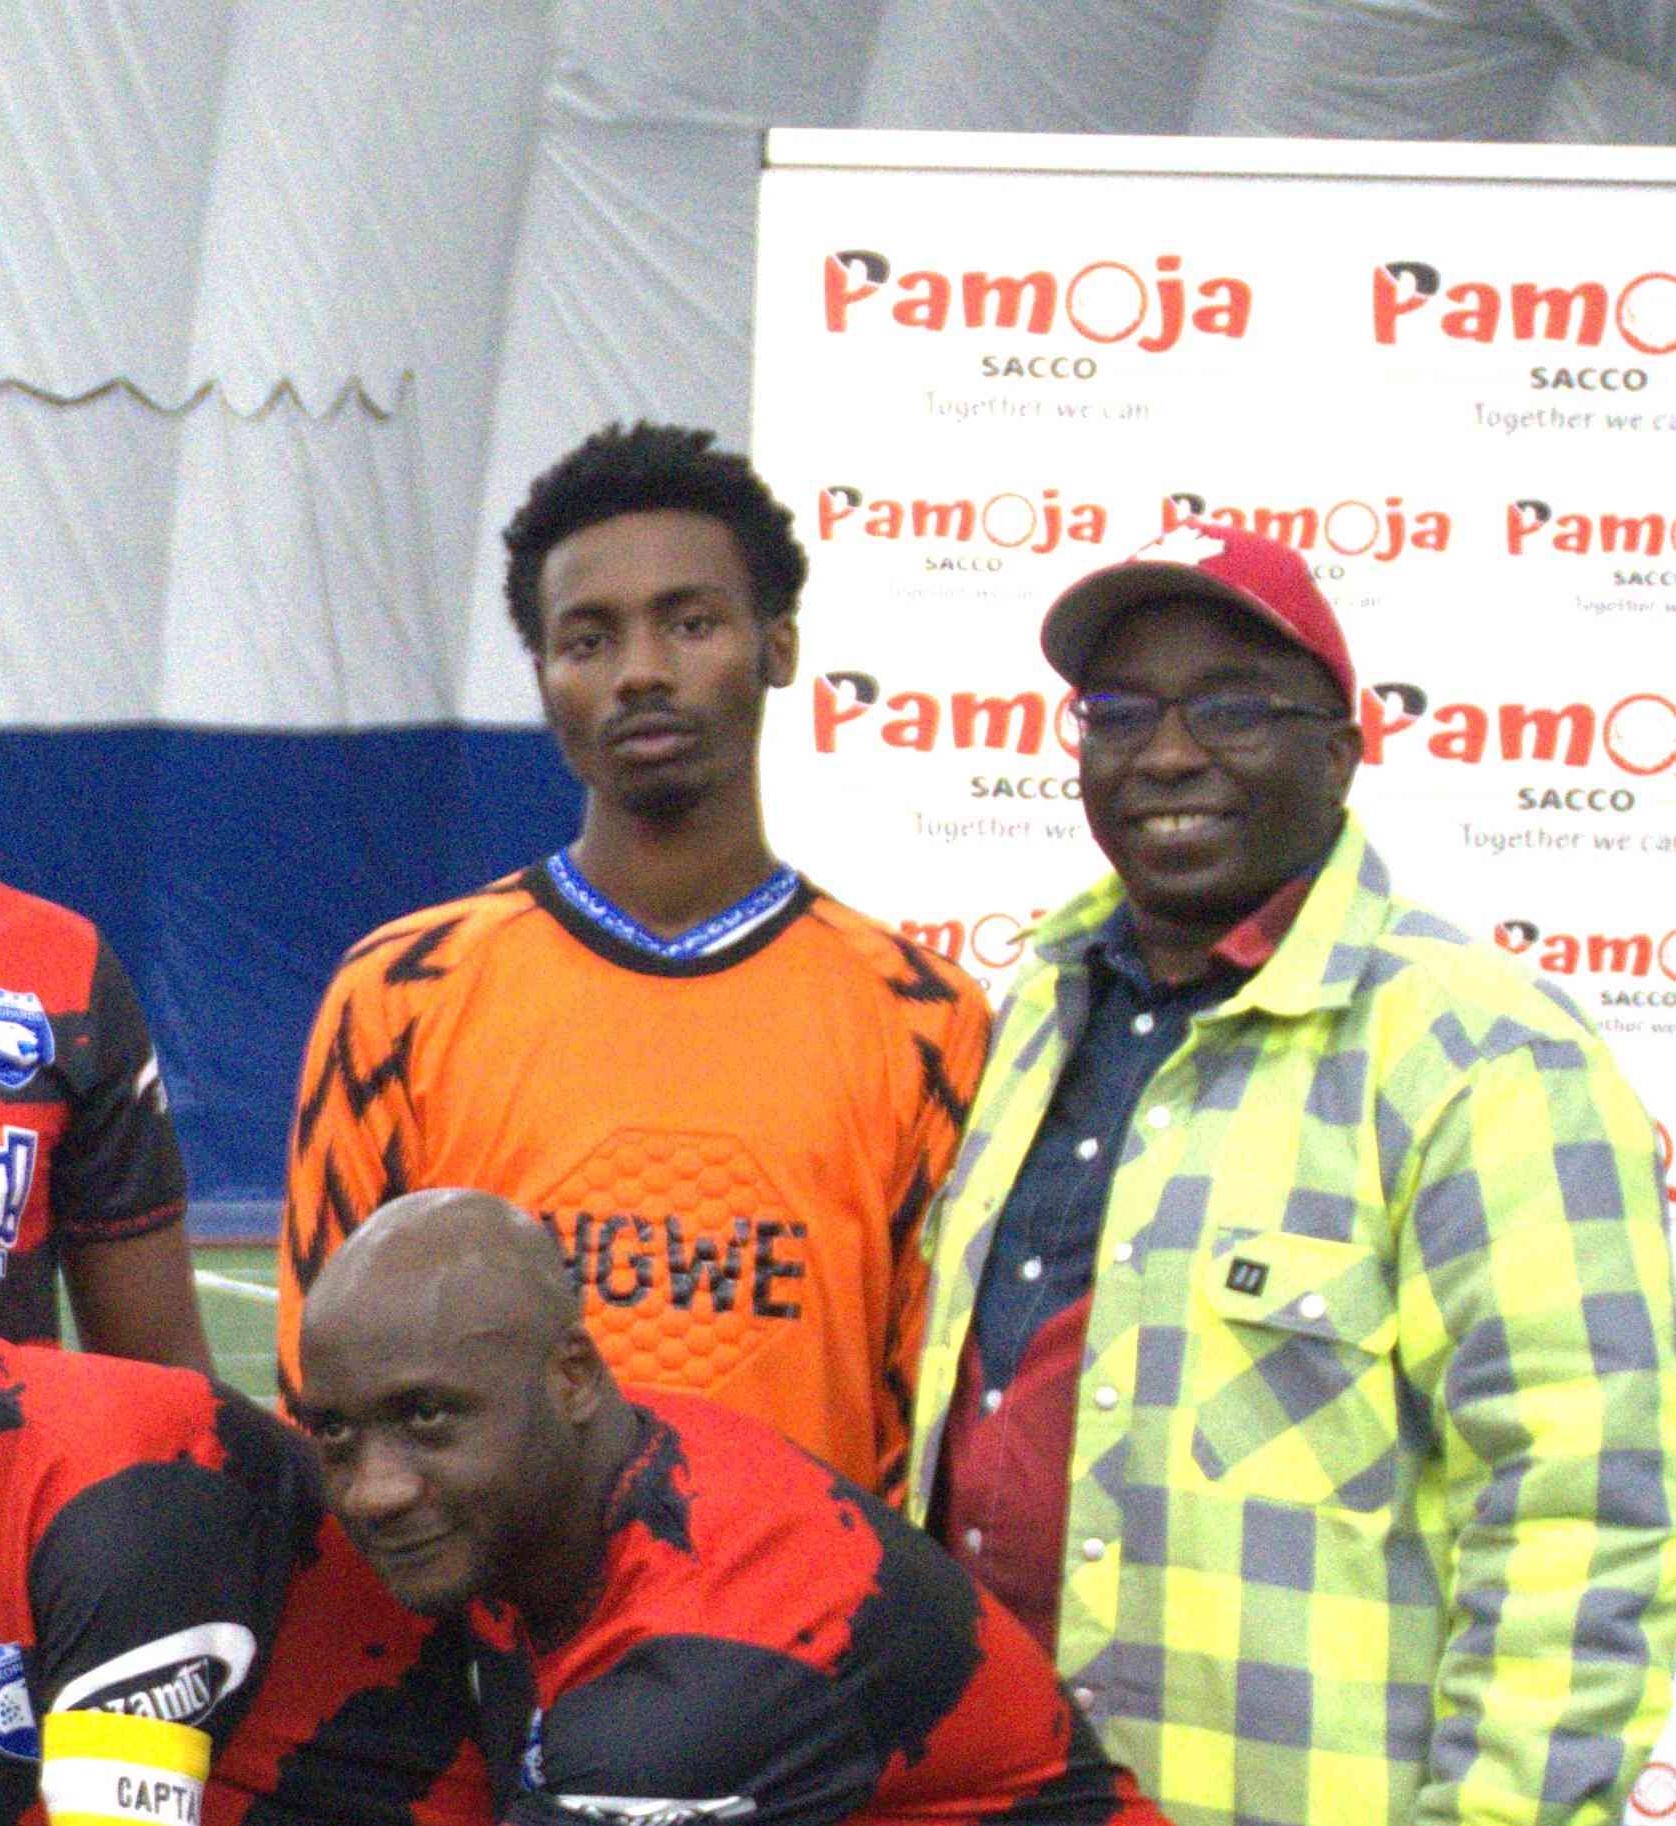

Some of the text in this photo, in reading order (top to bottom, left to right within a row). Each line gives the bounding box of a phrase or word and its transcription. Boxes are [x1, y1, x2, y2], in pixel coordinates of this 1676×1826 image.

[980, 355, 1099, 380] SACCO
[1528, 365, 1649, 392] SACCO
[1472, 401, 1595, 436] Together
[1605, 412, 1643, 431] we
[1505, 498, 1676, 558] Pam
[924, 557, 1003, 573] SACCO
[1516, 785, 1637, 813] SACCO
[1458, 821, 1584, 856] Together
[1592, 832, 1632, 852] we
